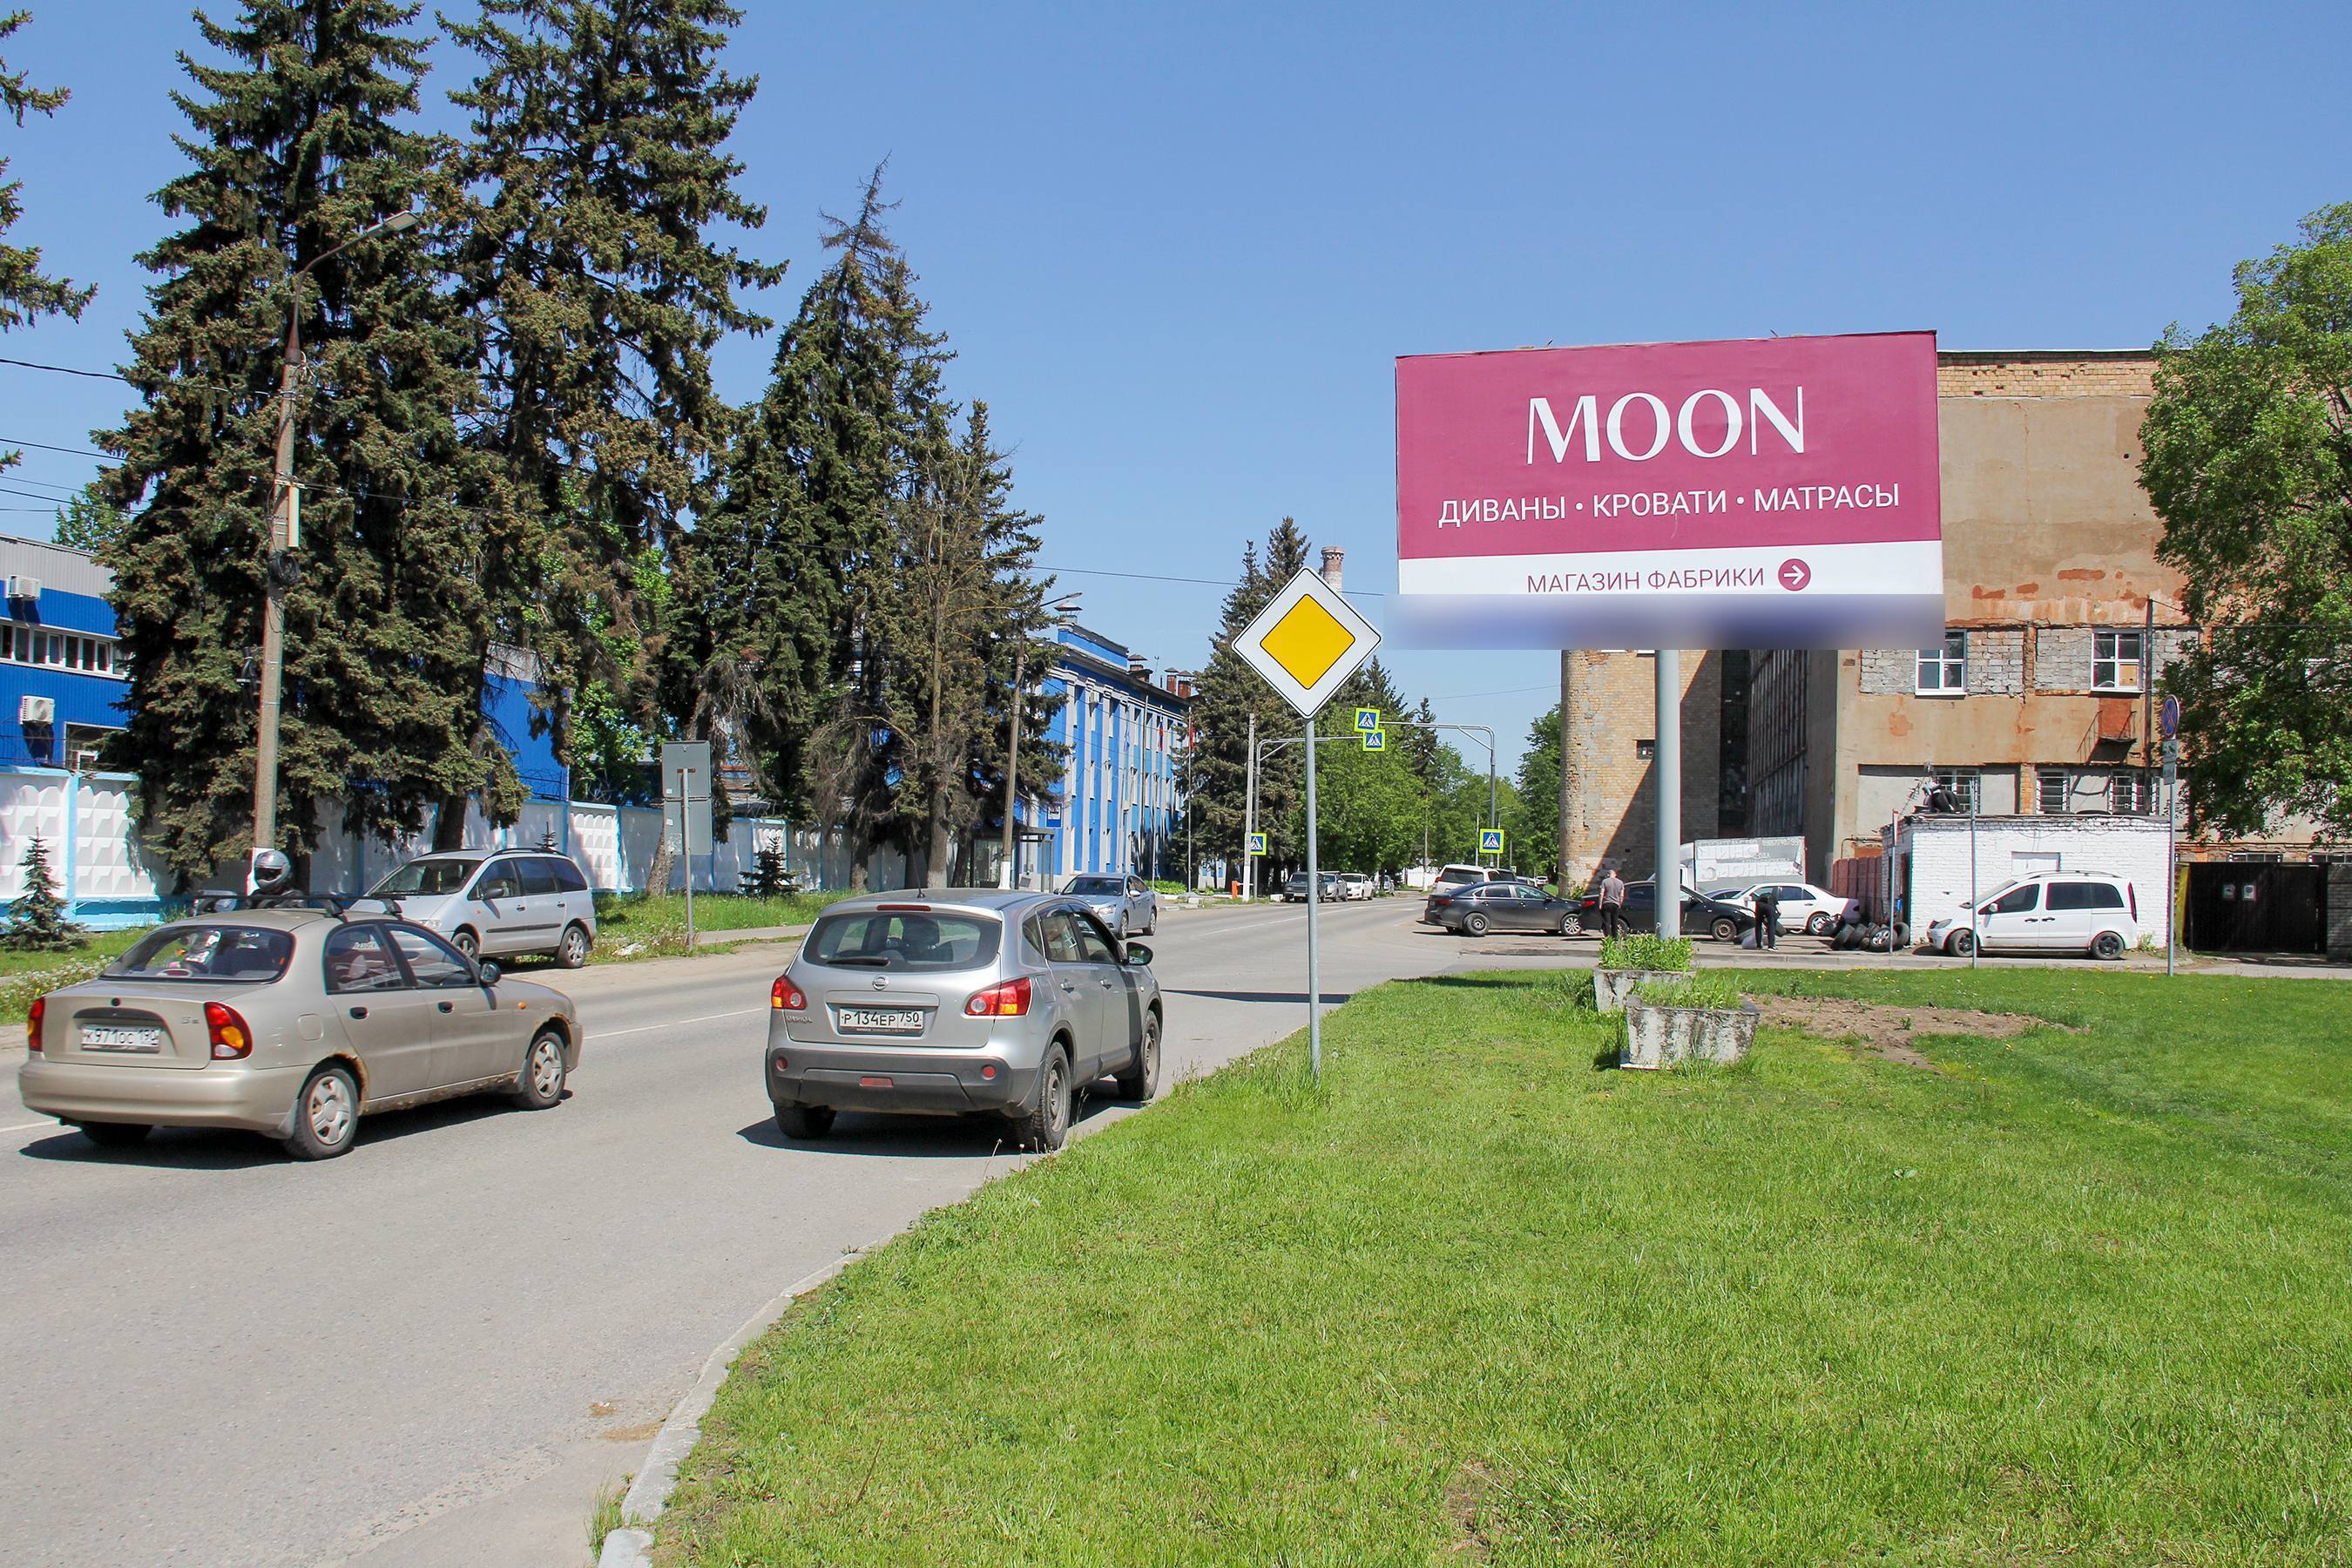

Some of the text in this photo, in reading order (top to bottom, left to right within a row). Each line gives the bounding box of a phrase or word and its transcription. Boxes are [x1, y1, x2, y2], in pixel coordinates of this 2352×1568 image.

[1527, 386, 1805, 464] MOON
[1438, 483, 1900, 529] ДИВАНЫ КРОВАТИ МАТРАСЫ
[1527, 567, 1765, 593] МАГАЗИН ФАБРИКИ
[844, 1011, 896, 1025] Р134ЕР
[899, 1011, 919, 1023] 750
